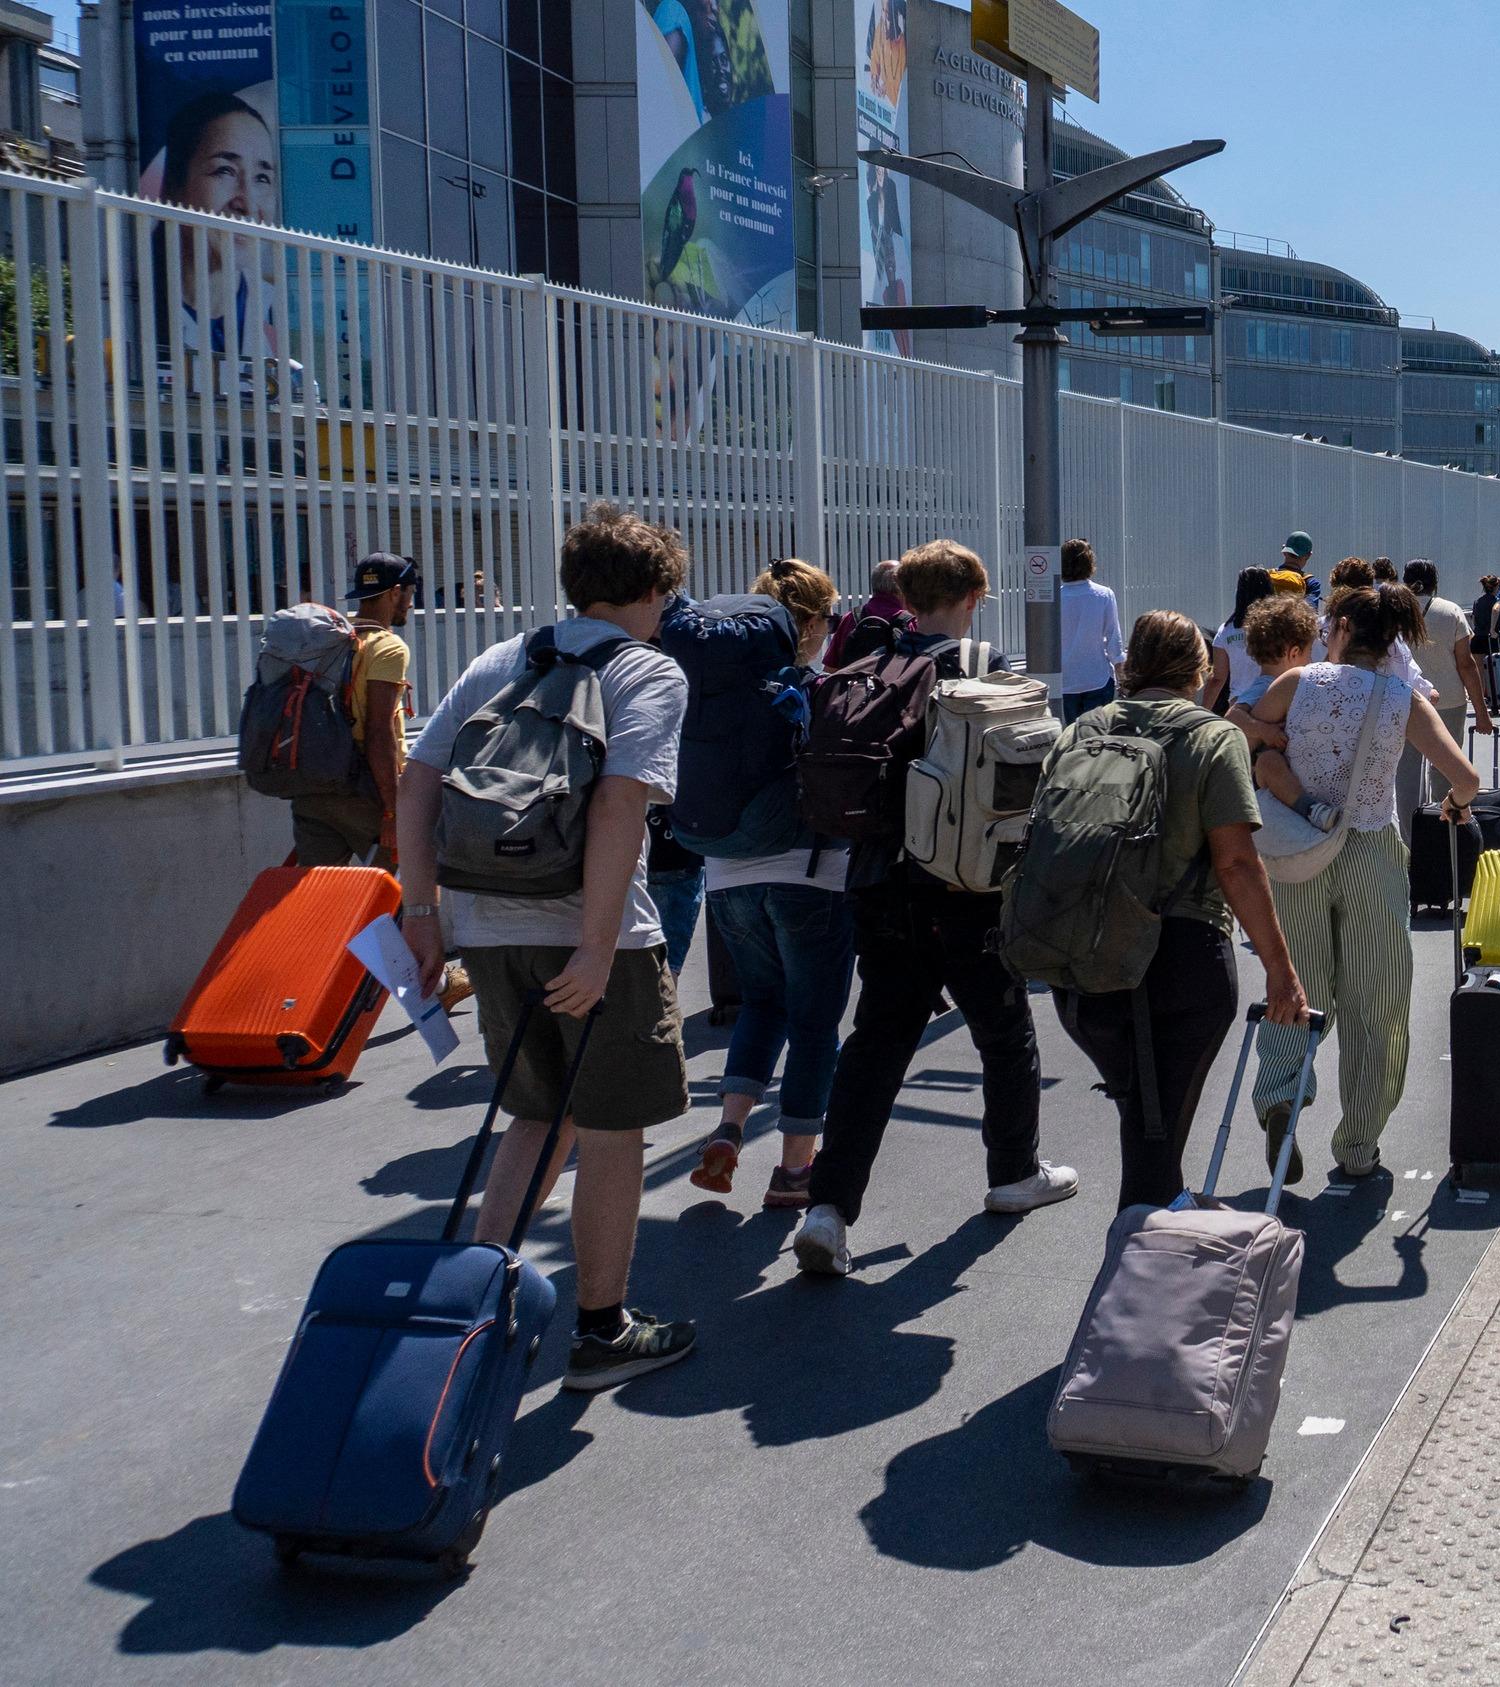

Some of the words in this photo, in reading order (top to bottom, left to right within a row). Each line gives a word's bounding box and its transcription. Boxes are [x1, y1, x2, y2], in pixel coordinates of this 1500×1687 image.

[143, 9, 180, 21] nous
[150, 30, 188, 46] pour
[192, 28, 213, 40] un
[218, 22, 272, 38] monde
[164, 51, 184, 62] en
[188, 48, 258, 61] commun
[935, 46, 999, 82] AGENCE
[935, 79, 956, 100] DE
[706, 159, 716, 176] la
[718, 164, 751, 188] France
[754, 176, 787, 200] investit
[710, 186, 734, 202] pour
[736, 194, 749, 207] un
[752, 199, 782, 218] monde
[720, 209, 731, 222] en
[734, 214, 774, 235] commun
